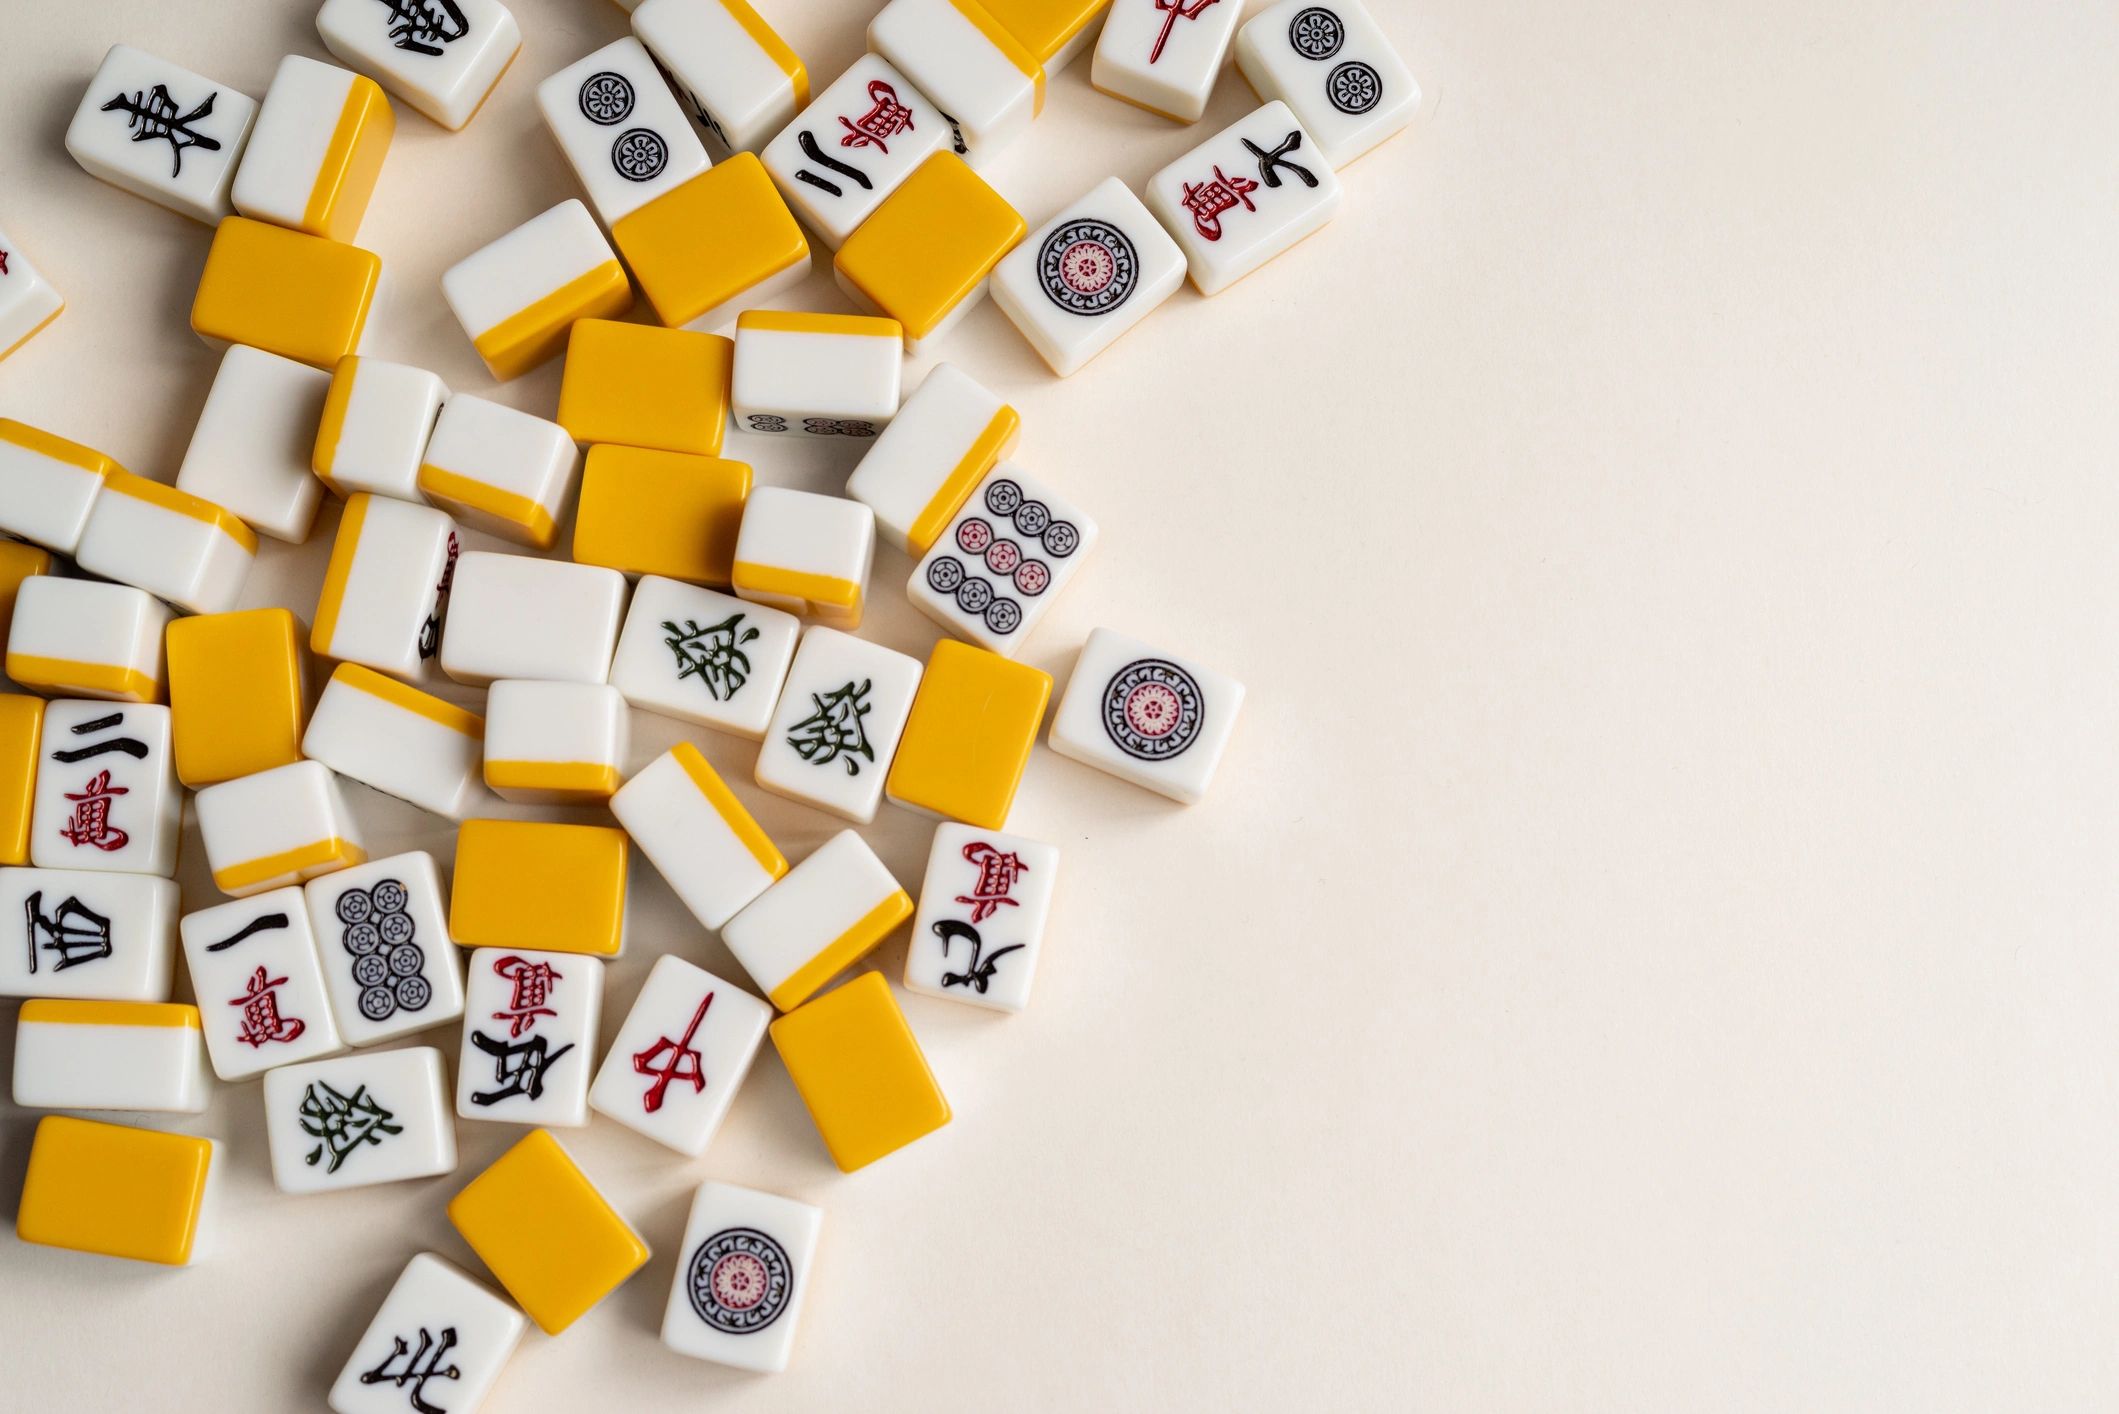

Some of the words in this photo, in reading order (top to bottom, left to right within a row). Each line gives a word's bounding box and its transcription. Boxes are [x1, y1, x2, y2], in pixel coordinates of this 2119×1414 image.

[100, 83, 222, 179] 東
[794, 79, 915, 198] 二萬
[661, 613, 760, 702] 發
[787, 678, 875, 777] 發
[51, 711, 149, 852] 二萬
[25, 890, 112, 975] 西
[931, 841, 1026, 995] 九萬
[632, 991, 714, 1113] 中
[299, 1079, 404, 1175] 發
